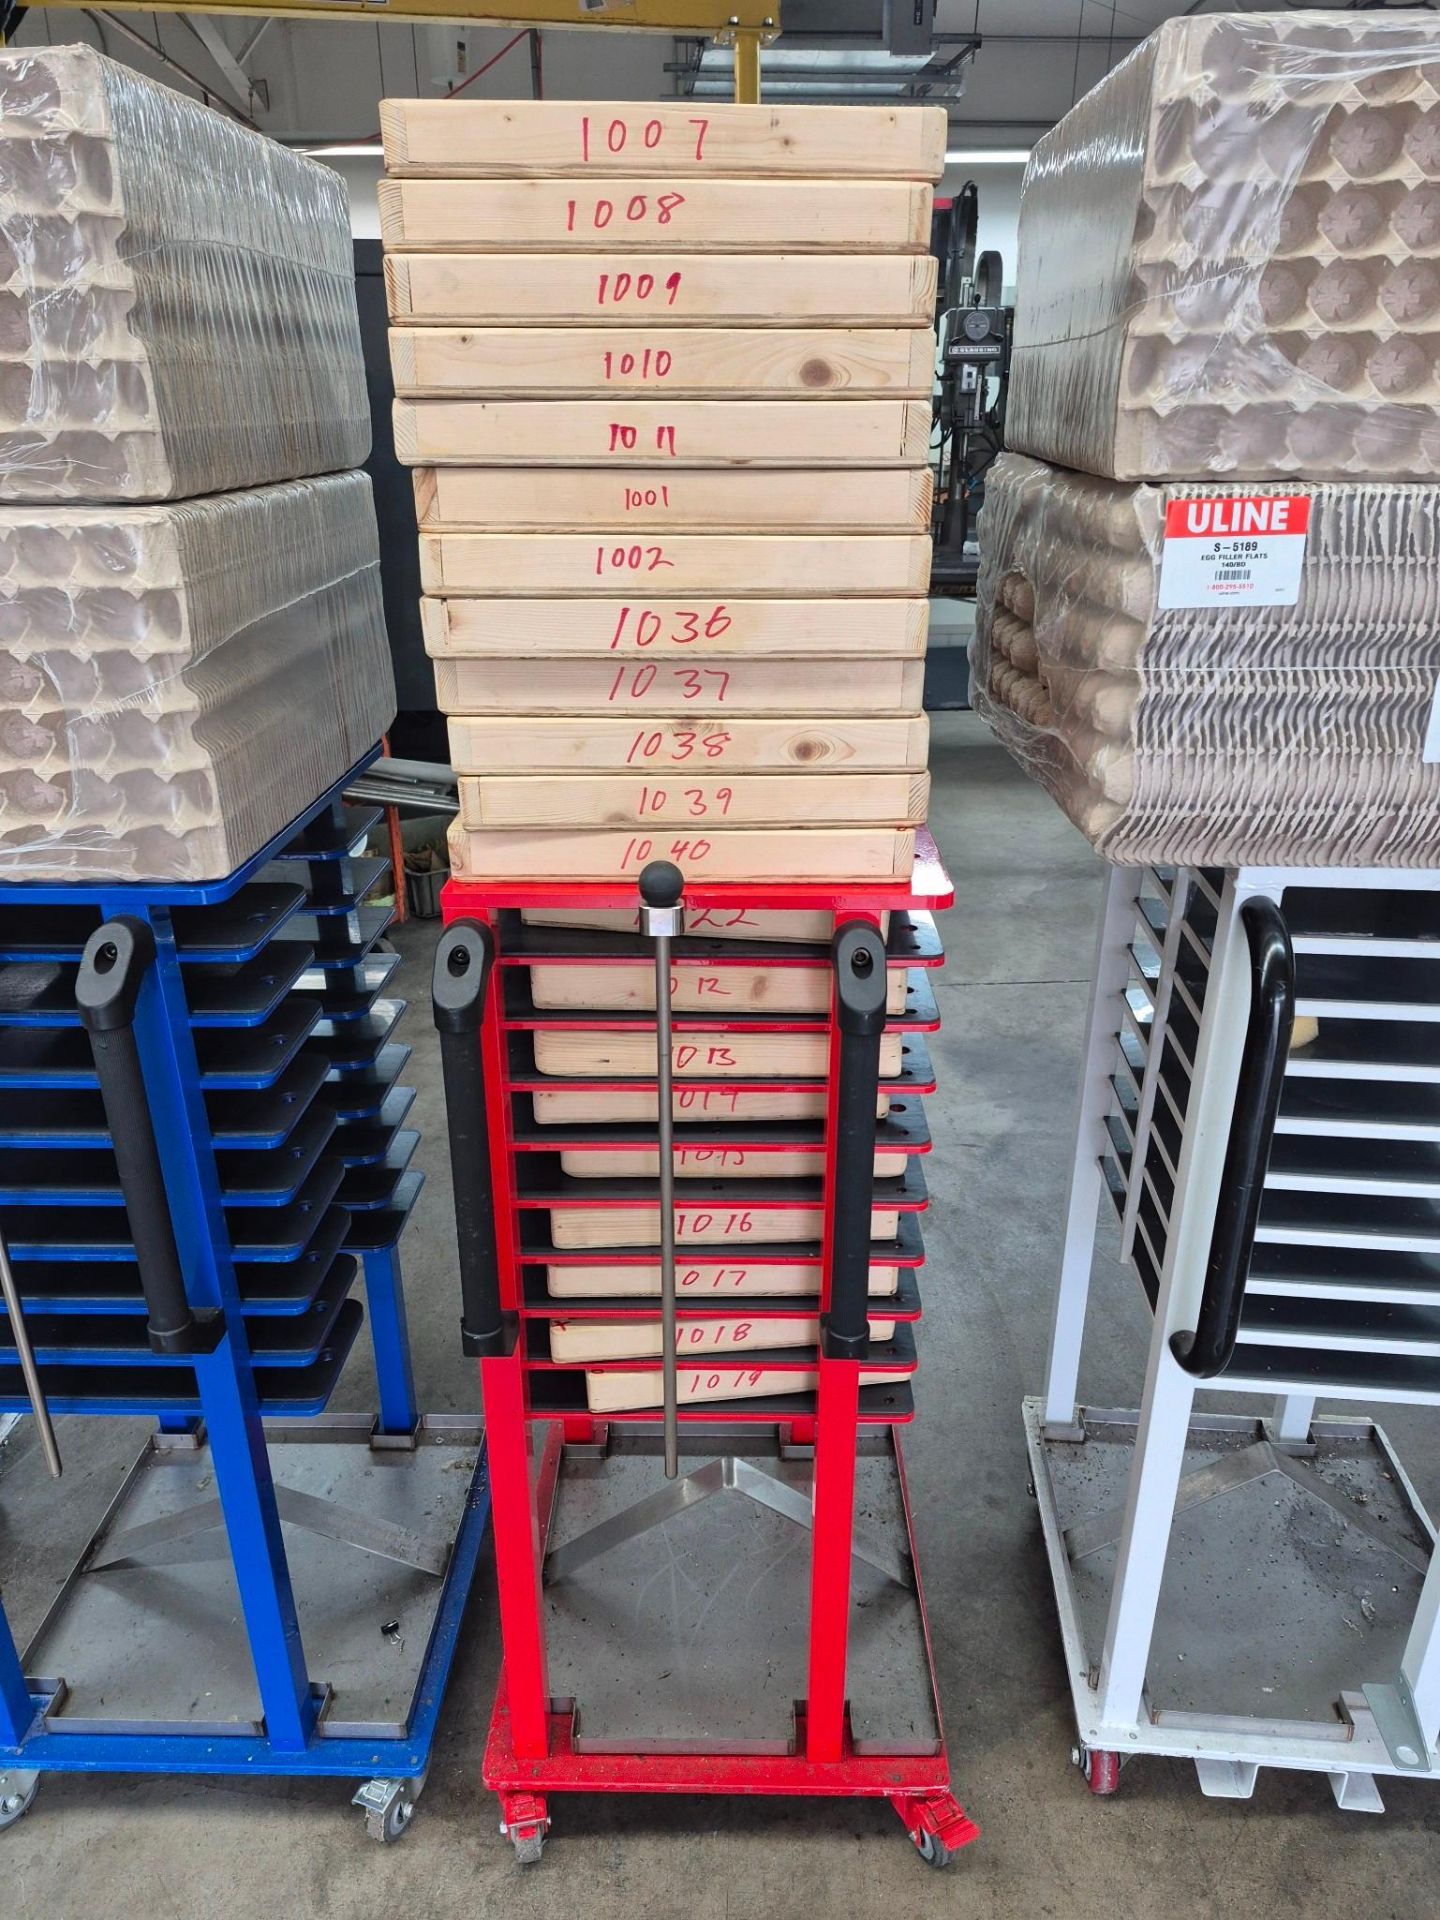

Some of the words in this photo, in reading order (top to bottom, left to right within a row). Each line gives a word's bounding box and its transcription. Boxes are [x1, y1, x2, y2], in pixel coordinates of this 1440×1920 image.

[581, 117, 710, 161] 1007
[566, 192, 686, 231] 1008
[597, 271, 682, 304] 1009
[603, 348, 672, 379] 1010
[608, 423, 677, 456] 1011
[624, 485, 669, 510] 1001
[1187, 500, 1290, 534] ULINE
[595, 546, 675, 575] 1002
[610, 605, 732, 649] 1036
[609, 664, 730, 701] 1037
[627, 731, 732, 763] 1038
[638, 786, 733, 815] 1039
[620, 838, 711, 870] 1040
[633, 909, 760, 928] 22
[670, 977, 732, 994] 12
[672, 1046, 736, 1068] 013
[679, 1091, 739, 1112] 014
[677, 1212, 753, 1235] 1016
[682, 1270, 747, 1287] 017
[675, 1323, 752, 1345] 1018
[691, 1370, 762, 1393] 1019
